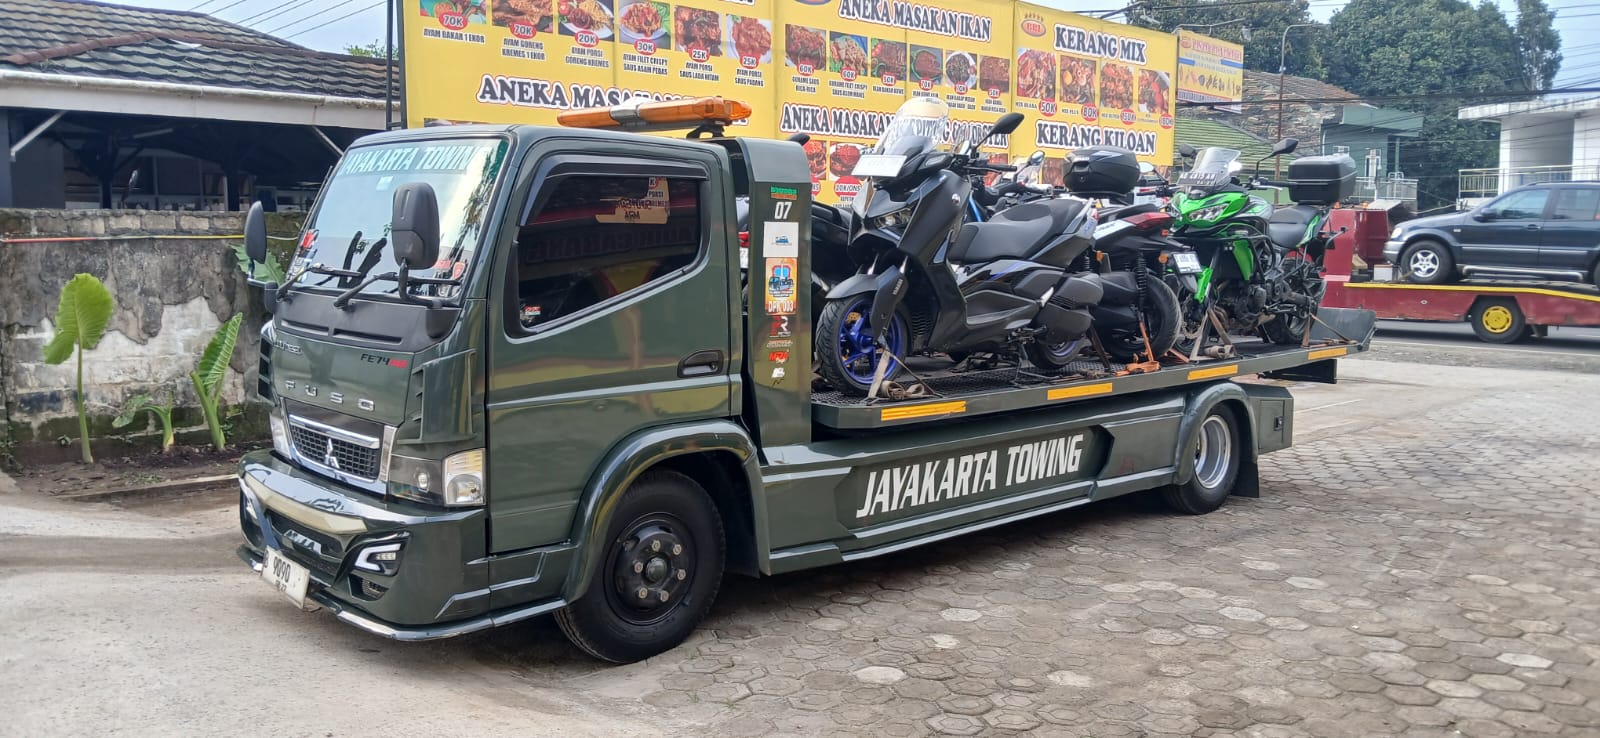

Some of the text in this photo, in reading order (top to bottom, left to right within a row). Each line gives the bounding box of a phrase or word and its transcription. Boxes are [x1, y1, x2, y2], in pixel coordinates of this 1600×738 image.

[444, 15, 463, 27] 70K
[840, 0, 990, 40] ANEKA MASAKAN IKAN
[423, 28, 441, 38] AYAM
[464, 33, 468, 41] 1
[514, 24, 533, 35] 70K
[503, 38, 519, 47] AYAM
[578, 34, 596, 44] 20K
[1055, 26, 1145, 63] KERANG MIX
[637, 42, 654, 52] 30K
[502, 48, 526, 58] KREMES
[692, 50, 706, 59] 25K
[743, 57, 757, 66] 25K
[799, 63, 812, 73] 60K
[842, 71, 855, 79] 60K
[479, 76, 568, 107] ANEKA
[1041, 102, 1056, 113] 50K
[1083, 107, 1097, 118] 80K
[781, 105, 832, 133] ANEKA
[1037, 122, 1155, 154] KERANG KILOAN
[774, 201, 792, 220] 07
[285, 379, 375, 412] FUSO
[856, 434, 1085, 518] JAYAKARTA TOWING
[273, 556, 291, 583] 9090
